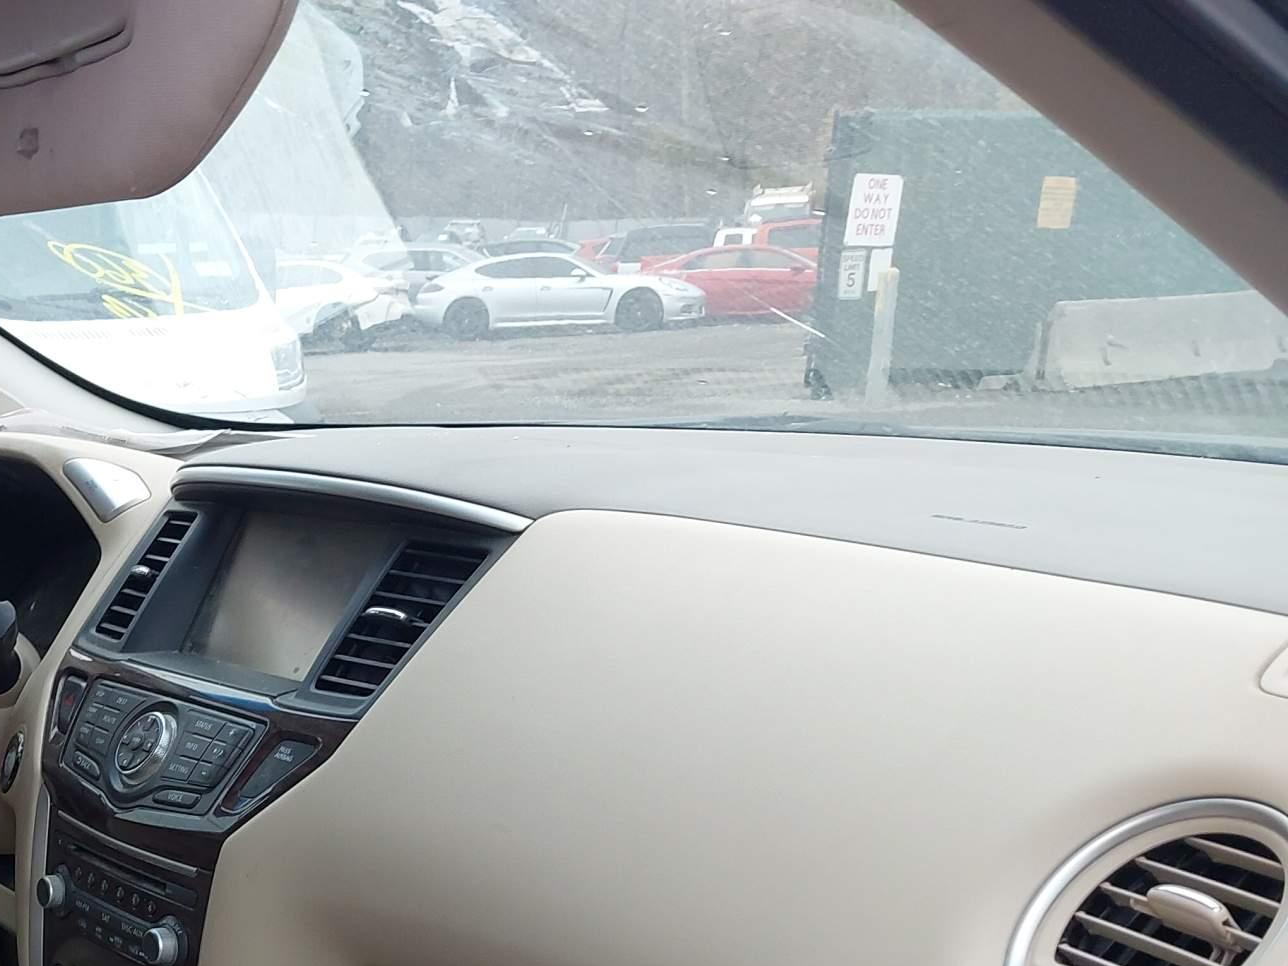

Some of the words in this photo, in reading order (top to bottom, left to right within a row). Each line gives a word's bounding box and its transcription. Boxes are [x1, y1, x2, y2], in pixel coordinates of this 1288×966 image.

[868, 178, 889, 190] ONE
[863, 193, 890, 204] WAY
[854, 208, 870, 219] DO
[870, 208, 892, 220] NOT
[855, 224, 886, 236] ENTER
[846, 272, 856, 287] 5
